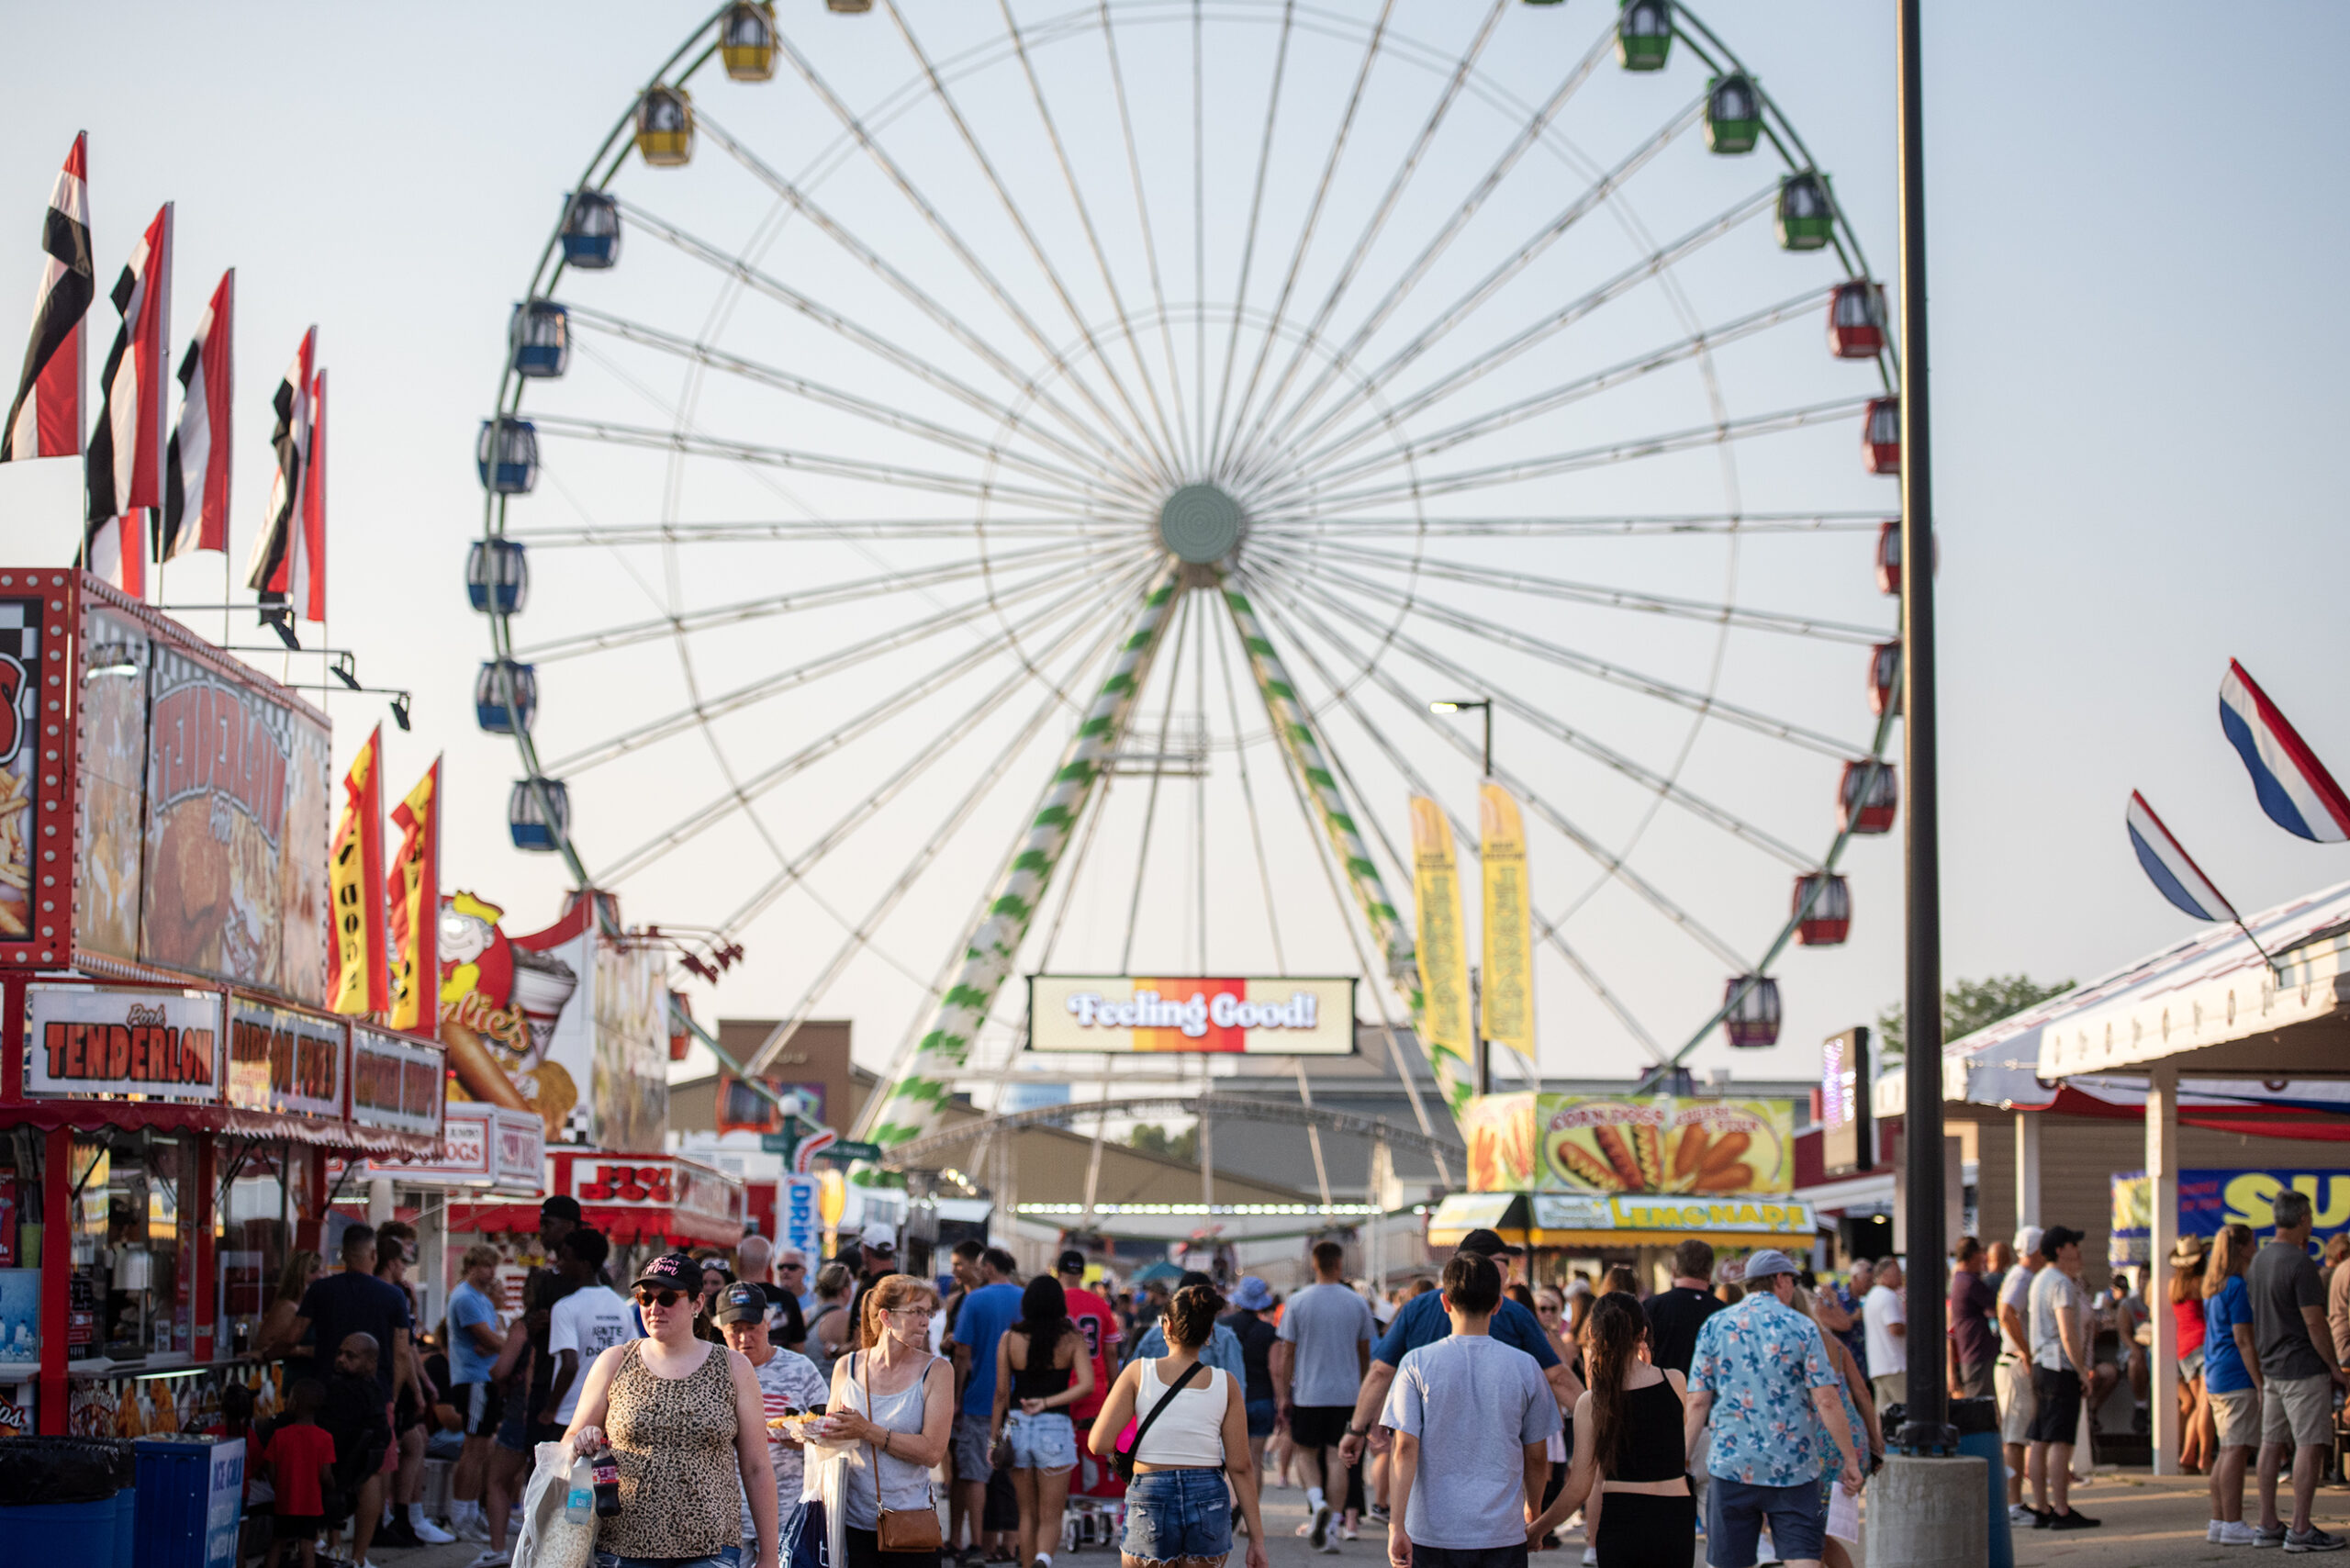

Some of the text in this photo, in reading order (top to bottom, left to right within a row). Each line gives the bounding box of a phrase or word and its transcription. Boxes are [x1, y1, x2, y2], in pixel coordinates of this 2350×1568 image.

[127, 1002, 166, 1026] Pork
[1067, 990, 1318, 1037] Feeling Good!
[44, 1022, 214, 1086] TENDERLOIN
[1550, 1106, 1666, 1131] CORN DOGS
[444, 1141, 480, 1162] OGS
[1610, 1197, 1806, 1231] LEMONADE
[598, 1337, 614, 1347] THE
[1065, 1314, 1102, 1359] 3
